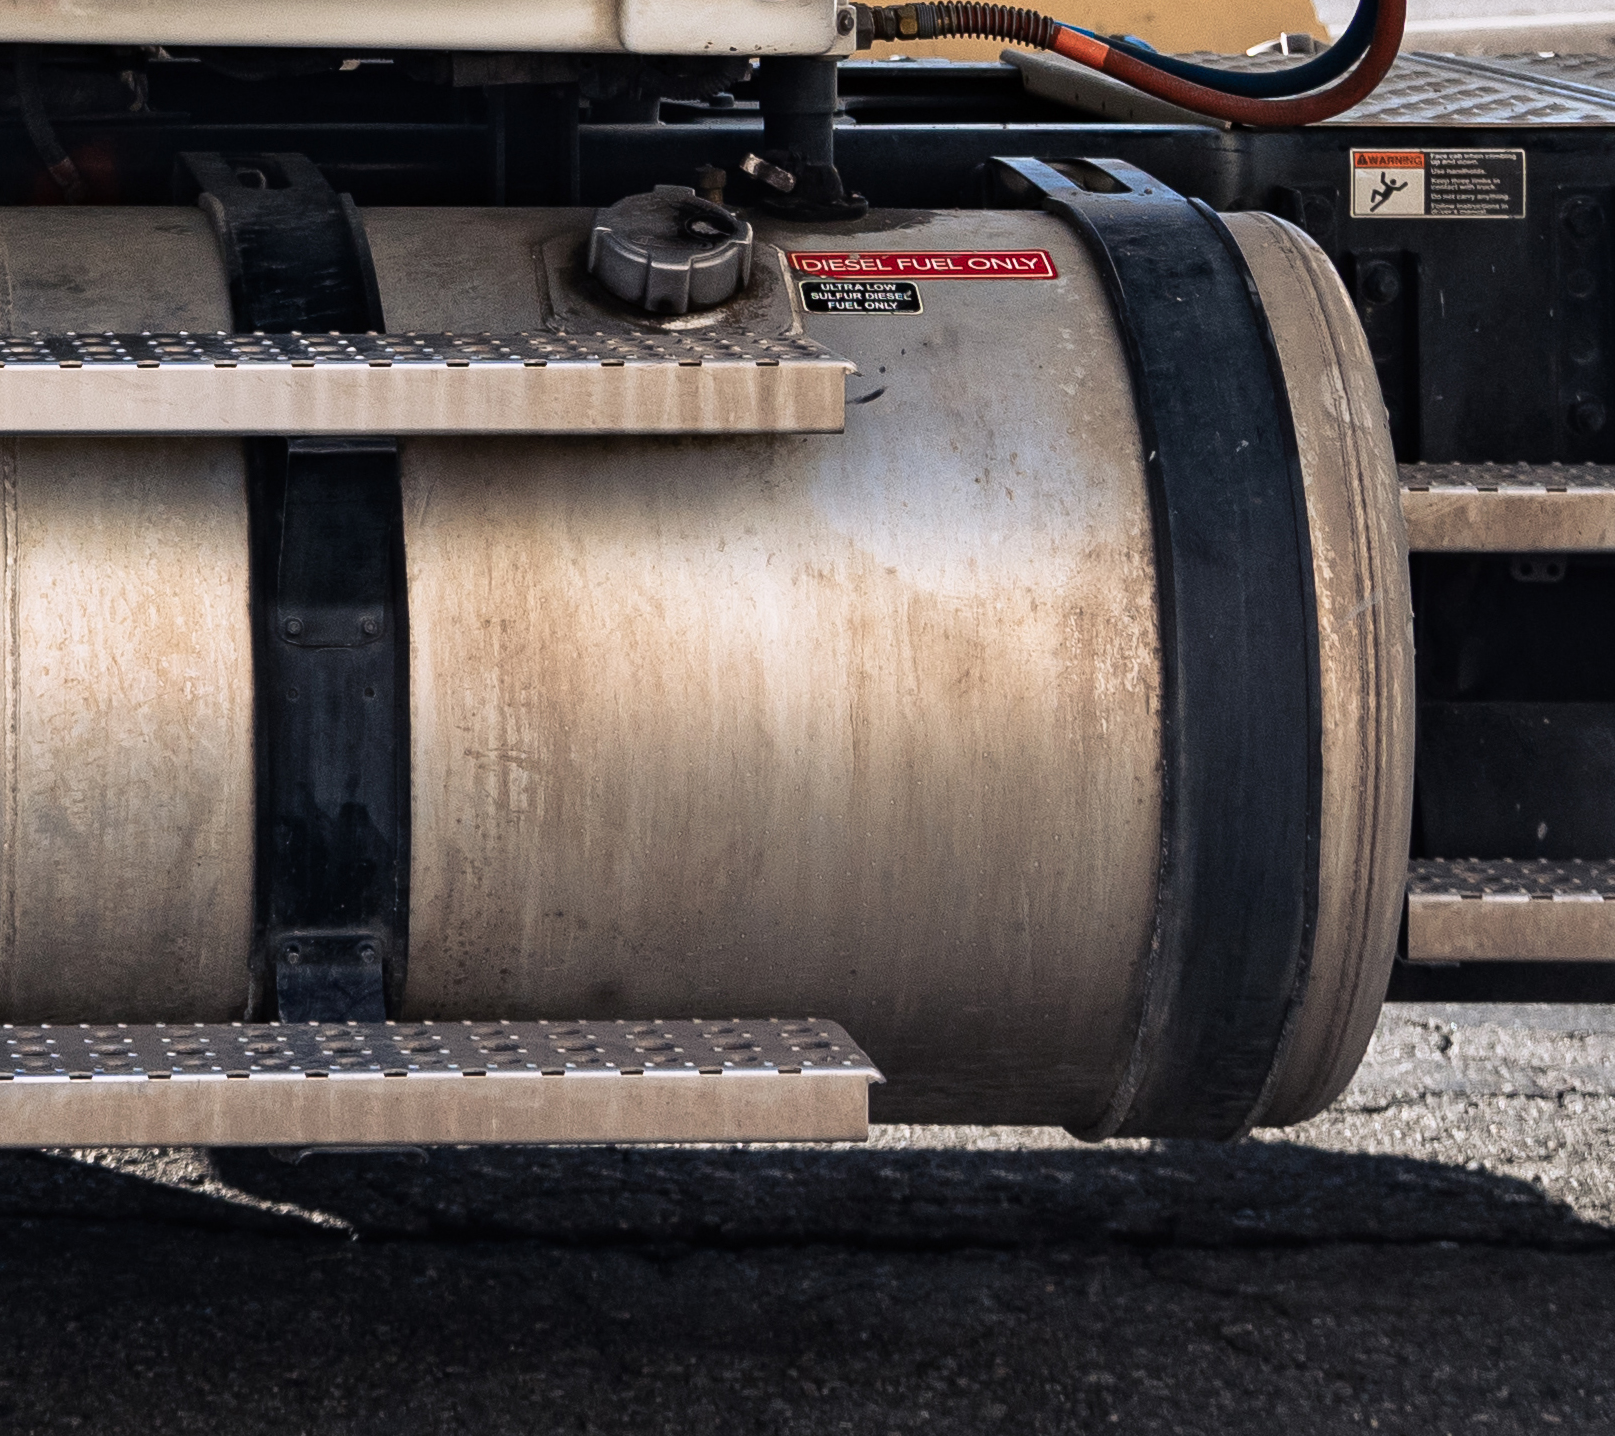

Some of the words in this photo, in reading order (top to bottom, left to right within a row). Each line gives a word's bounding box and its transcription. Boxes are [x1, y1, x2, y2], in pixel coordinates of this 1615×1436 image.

[1368, 153, 1423, 166] WARNING
[801, 258, 892, 272] DIESEL
[896, 257, 962, 271] FUEL
[967, 256, 1039, 270] ONLY
[820, 282, 864, 291] ULTRA
[866, 282, 896, 291] LOW
[811, 291, 862, 300] SULFUR
[865, 291, 912, 301] DIESEL
[827, 301, 862, 310] FUEL
[864, 301, 898, 309] ONLY
